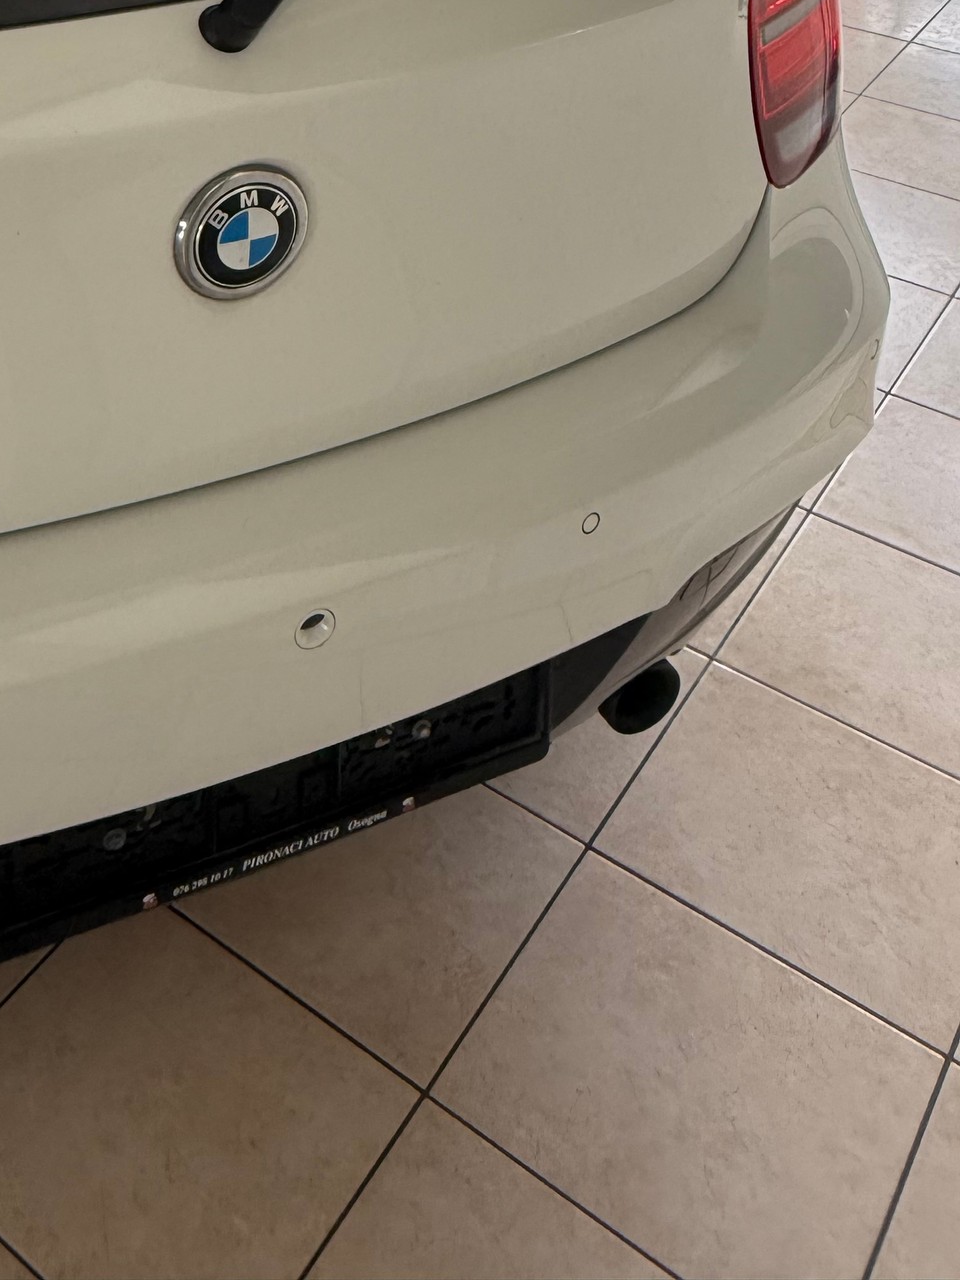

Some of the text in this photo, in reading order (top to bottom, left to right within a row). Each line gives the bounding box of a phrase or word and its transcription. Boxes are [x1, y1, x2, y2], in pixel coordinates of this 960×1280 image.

[207, 189, 290, 230] BMW
[242, 841, 303, 872] PIRONACI
[306, 826, 340, 846] AUTO
